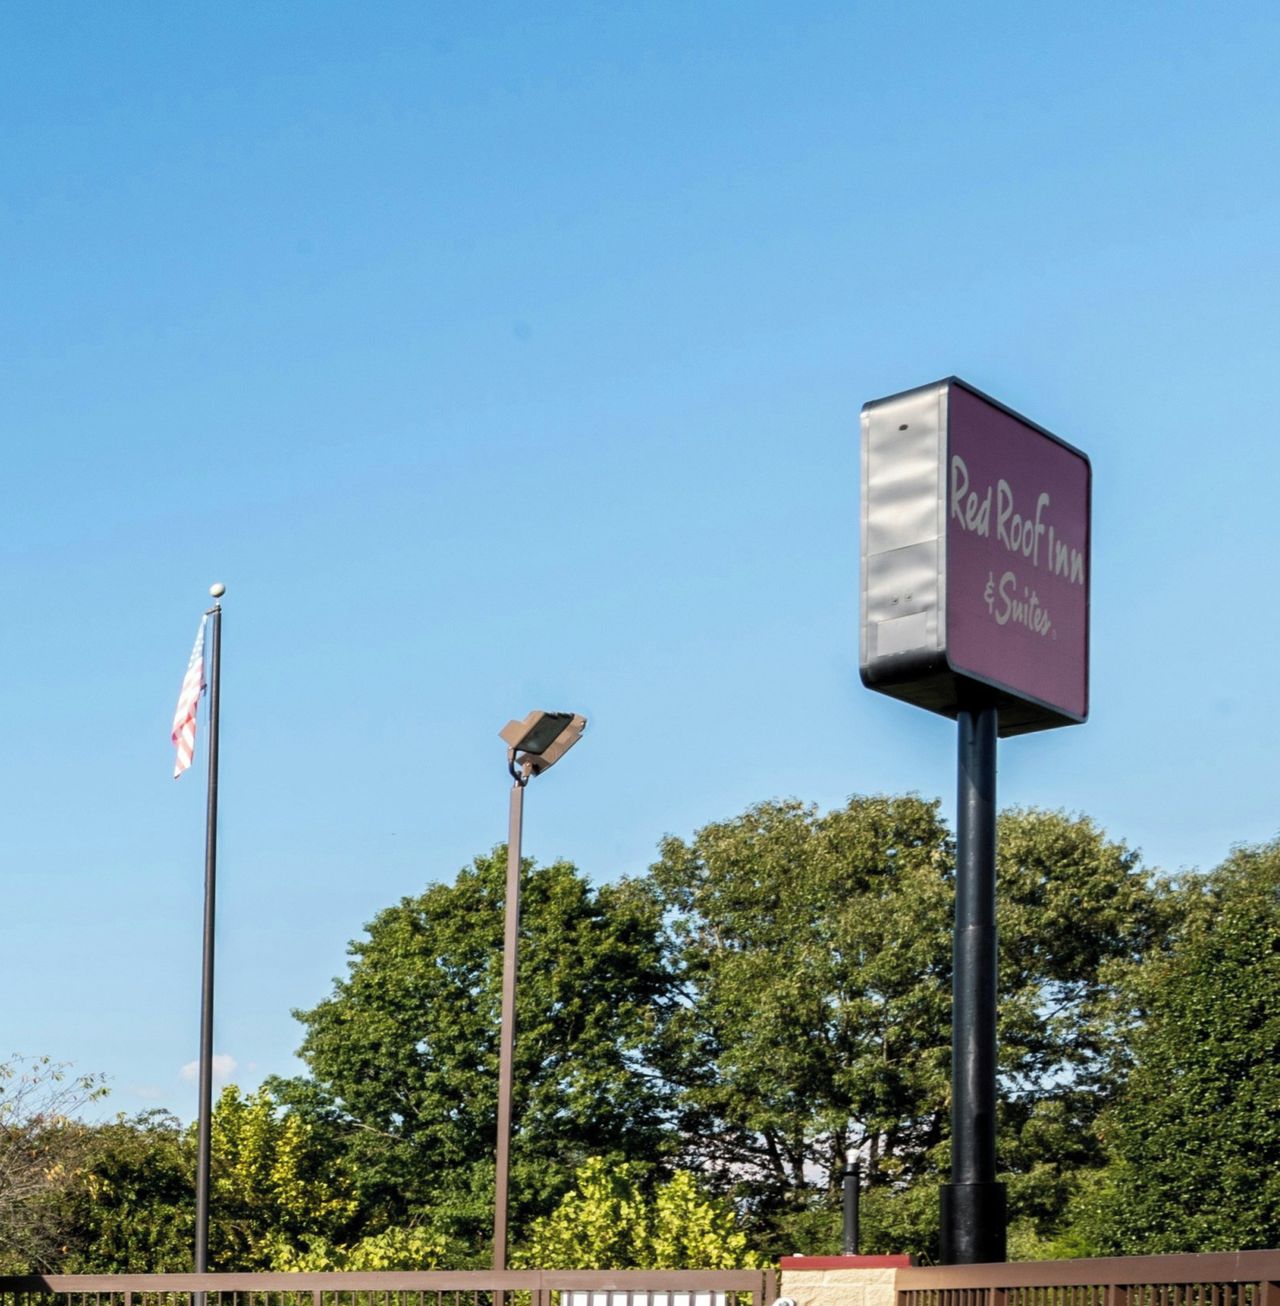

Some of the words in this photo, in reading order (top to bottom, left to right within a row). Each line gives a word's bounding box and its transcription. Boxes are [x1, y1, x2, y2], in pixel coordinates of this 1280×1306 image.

[951, 455, 992, 538] Red
[997, 478, 1050, 567] Roof
[1048, 525, 1084, 586] Inn
[984, 571, 995, 614] &
[995, 571, 1051, 636] Suites
